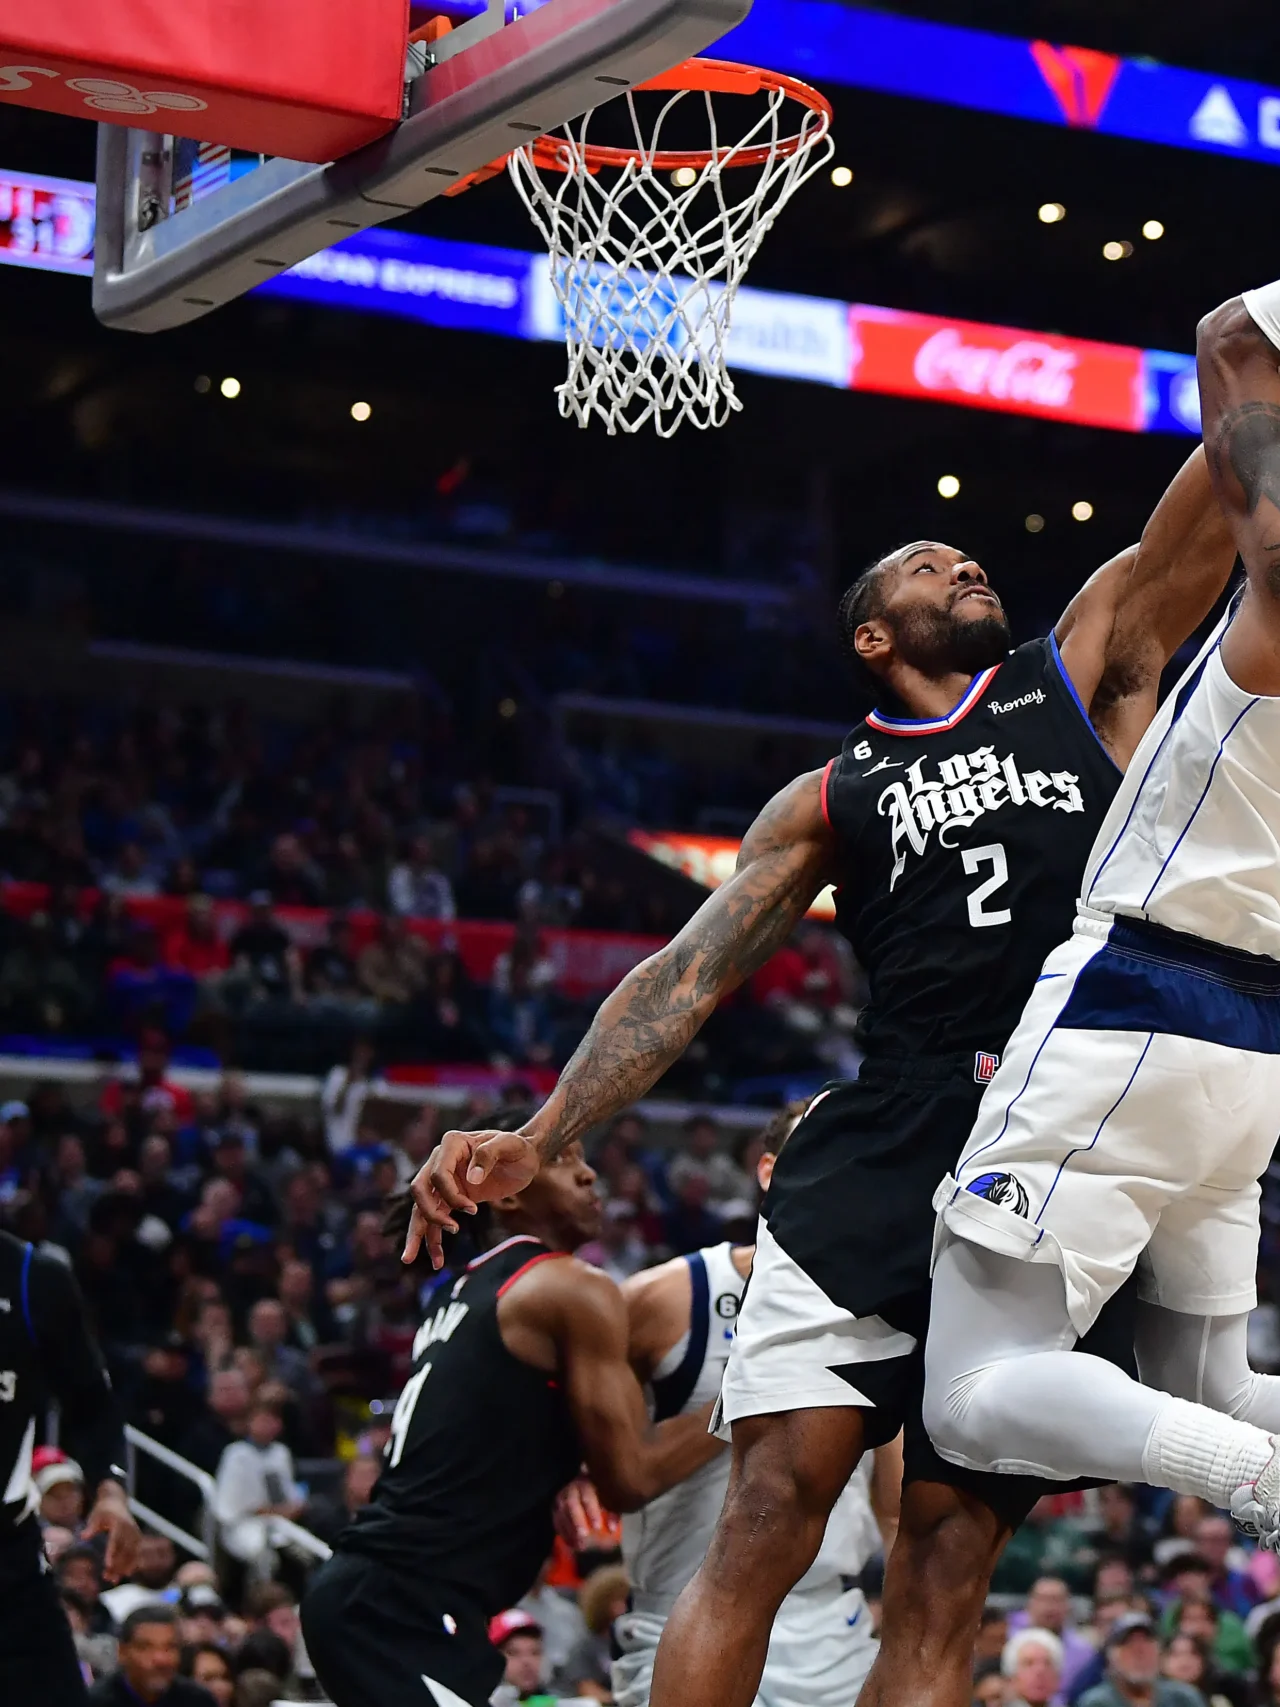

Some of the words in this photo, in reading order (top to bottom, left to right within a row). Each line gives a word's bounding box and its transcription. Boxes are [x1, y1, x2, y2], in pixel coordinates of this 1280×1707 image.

[988, 688, 1046, 715] honey
[853, 740, 872, 760] 6
[904, 745, 1001, 799] Los
[877, 752, 1085, 892] Angeles
[961, 843, 1012, 928] 2
